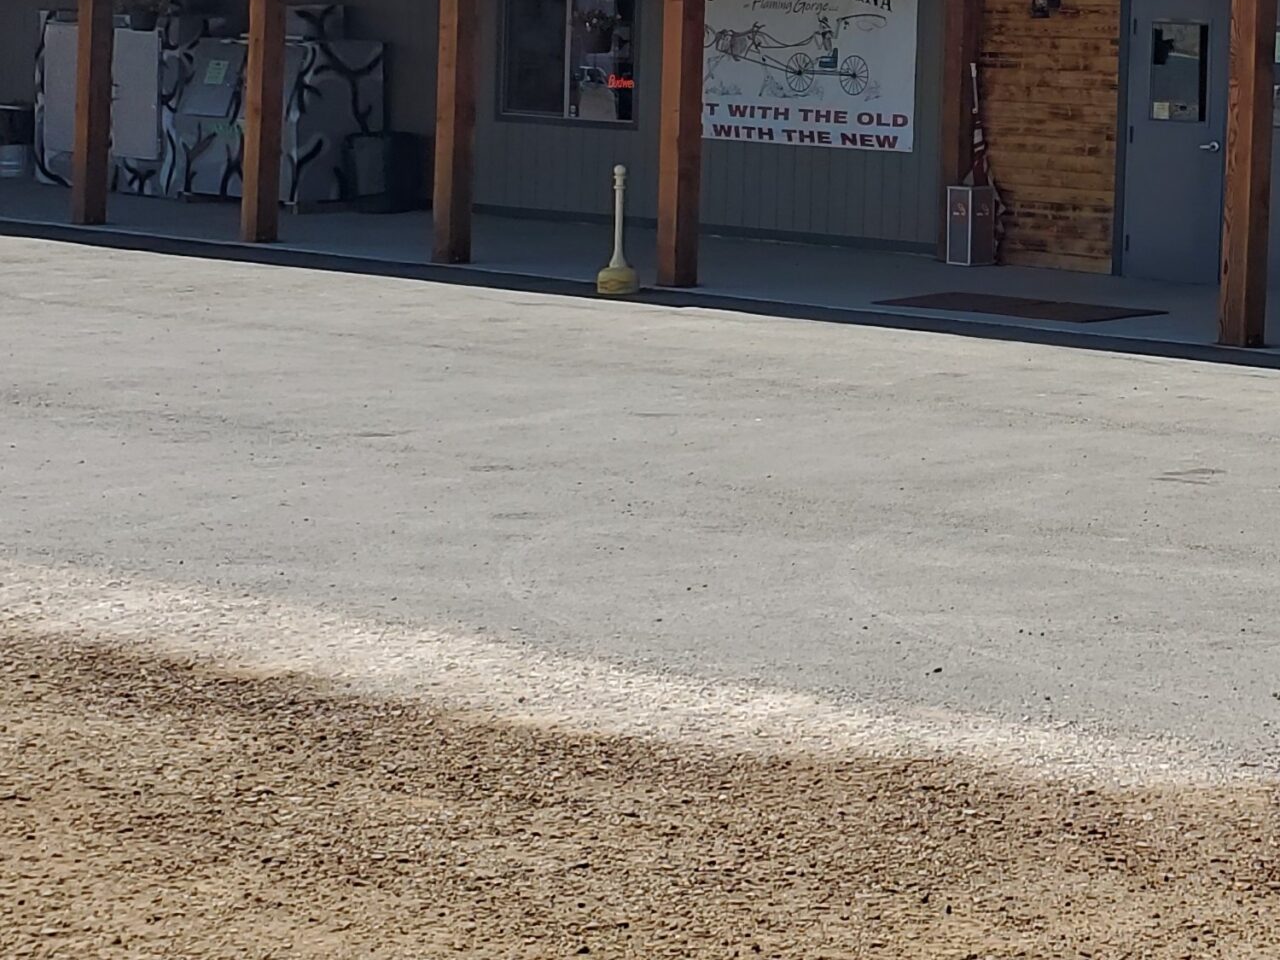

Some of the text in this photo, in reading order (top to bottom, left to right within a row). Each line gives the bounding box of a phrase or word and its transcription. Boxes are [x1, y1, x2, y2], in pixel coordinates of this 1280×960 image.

[728, 104, 789, 121] WITH
[798, 108, 848, 124] THE
[857, 112, 909, 128] OLD
[712, 124, 774, 141] WITH
[781, 129, 833, 144] THE
[840, 132, 899, 149] NEW
